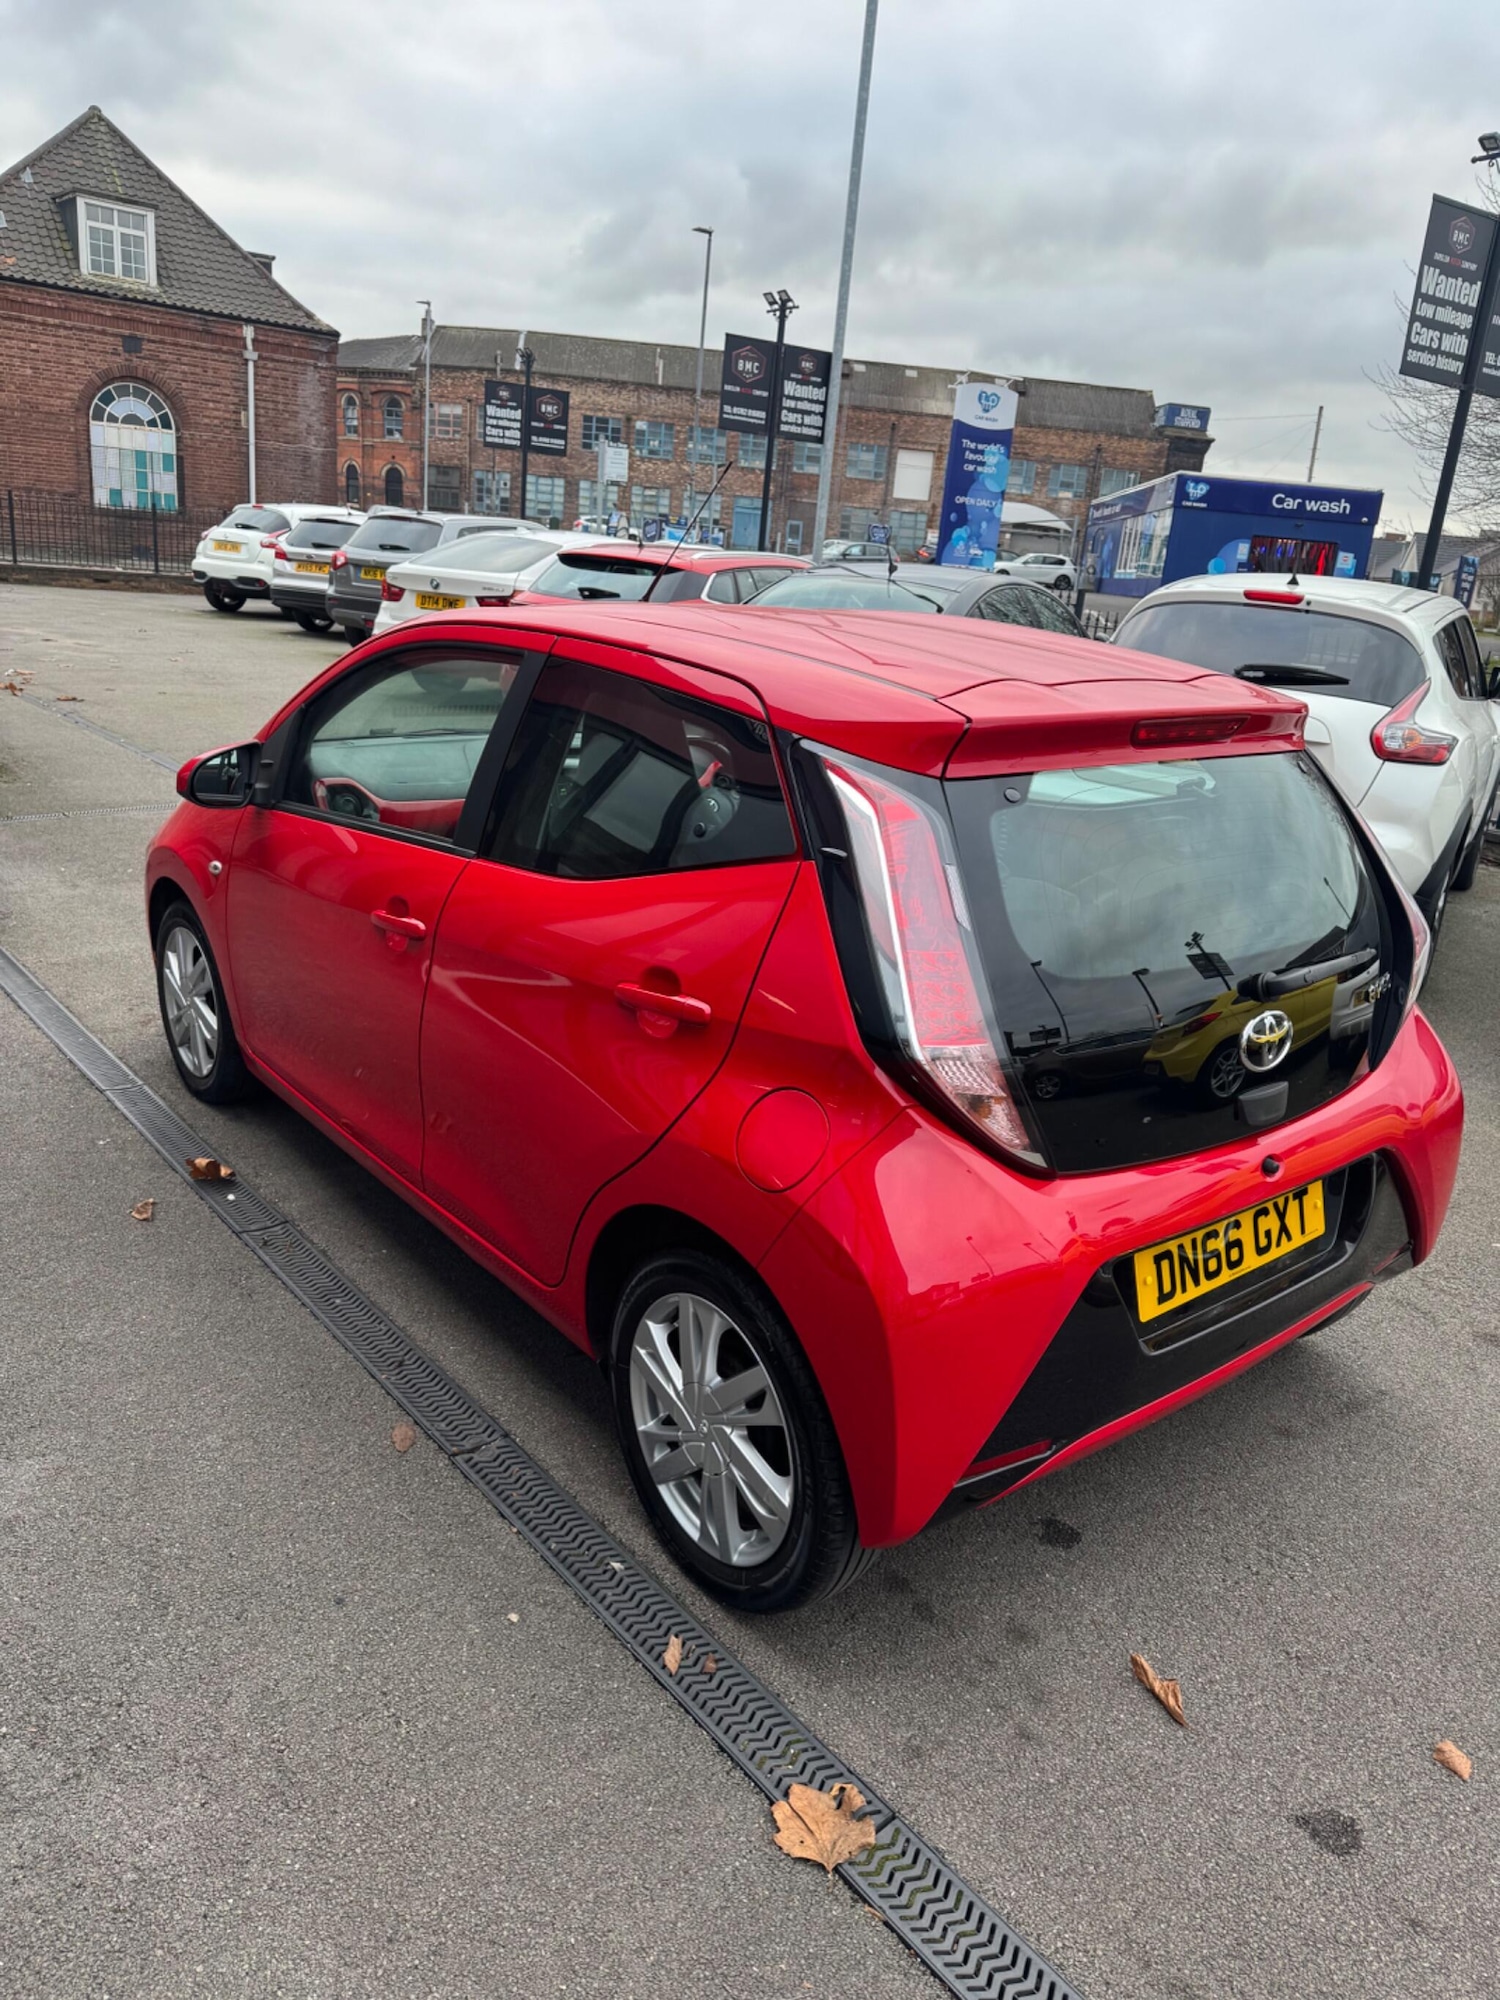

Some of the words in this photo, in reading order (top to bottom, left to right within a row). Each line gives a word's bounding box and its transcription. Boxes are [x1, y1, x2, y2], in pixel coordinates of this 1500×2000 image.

[1452, 229, 1470, 245] BMC
[1420, 264, 1482, 308] Wanted
[1415, 298, 1435, 318] Low
[1434, 303, 1473, 329] mileage
[1410, 321, 1440, 349] Cars
[1441, 329, 1469, 357] with
[737, 359, 760, 374] BMC
[1407, 348, 1437, 367] service
[1436, 354, 1465, 375] history
[783, 380, 827, 401] Wanted
[486, 405, 521, 420] Wanted
[541, 404, 559, 414] BMC
[782, 397, 796, 408] Low
[796, 399, 824, 413] mileage
[781, 409, 802, 424] Cars
[803, 413, 823, 427] with
[961, 439, 976, 449] The
[977, 442, 1005, 454] world's
[963, 464, 976, 472] car
[976, 465, 997, 474] wash
[955, 495, 974, 506] OPEN
[975, 497, 997, 508] DAILY
[1272, 493, 1302, 511] Car
[1305, 498, 1351, 515] wash
[1153, 1218, 1244, 1306] DN66
[1252, 1186, 1309, 1257] GXT
